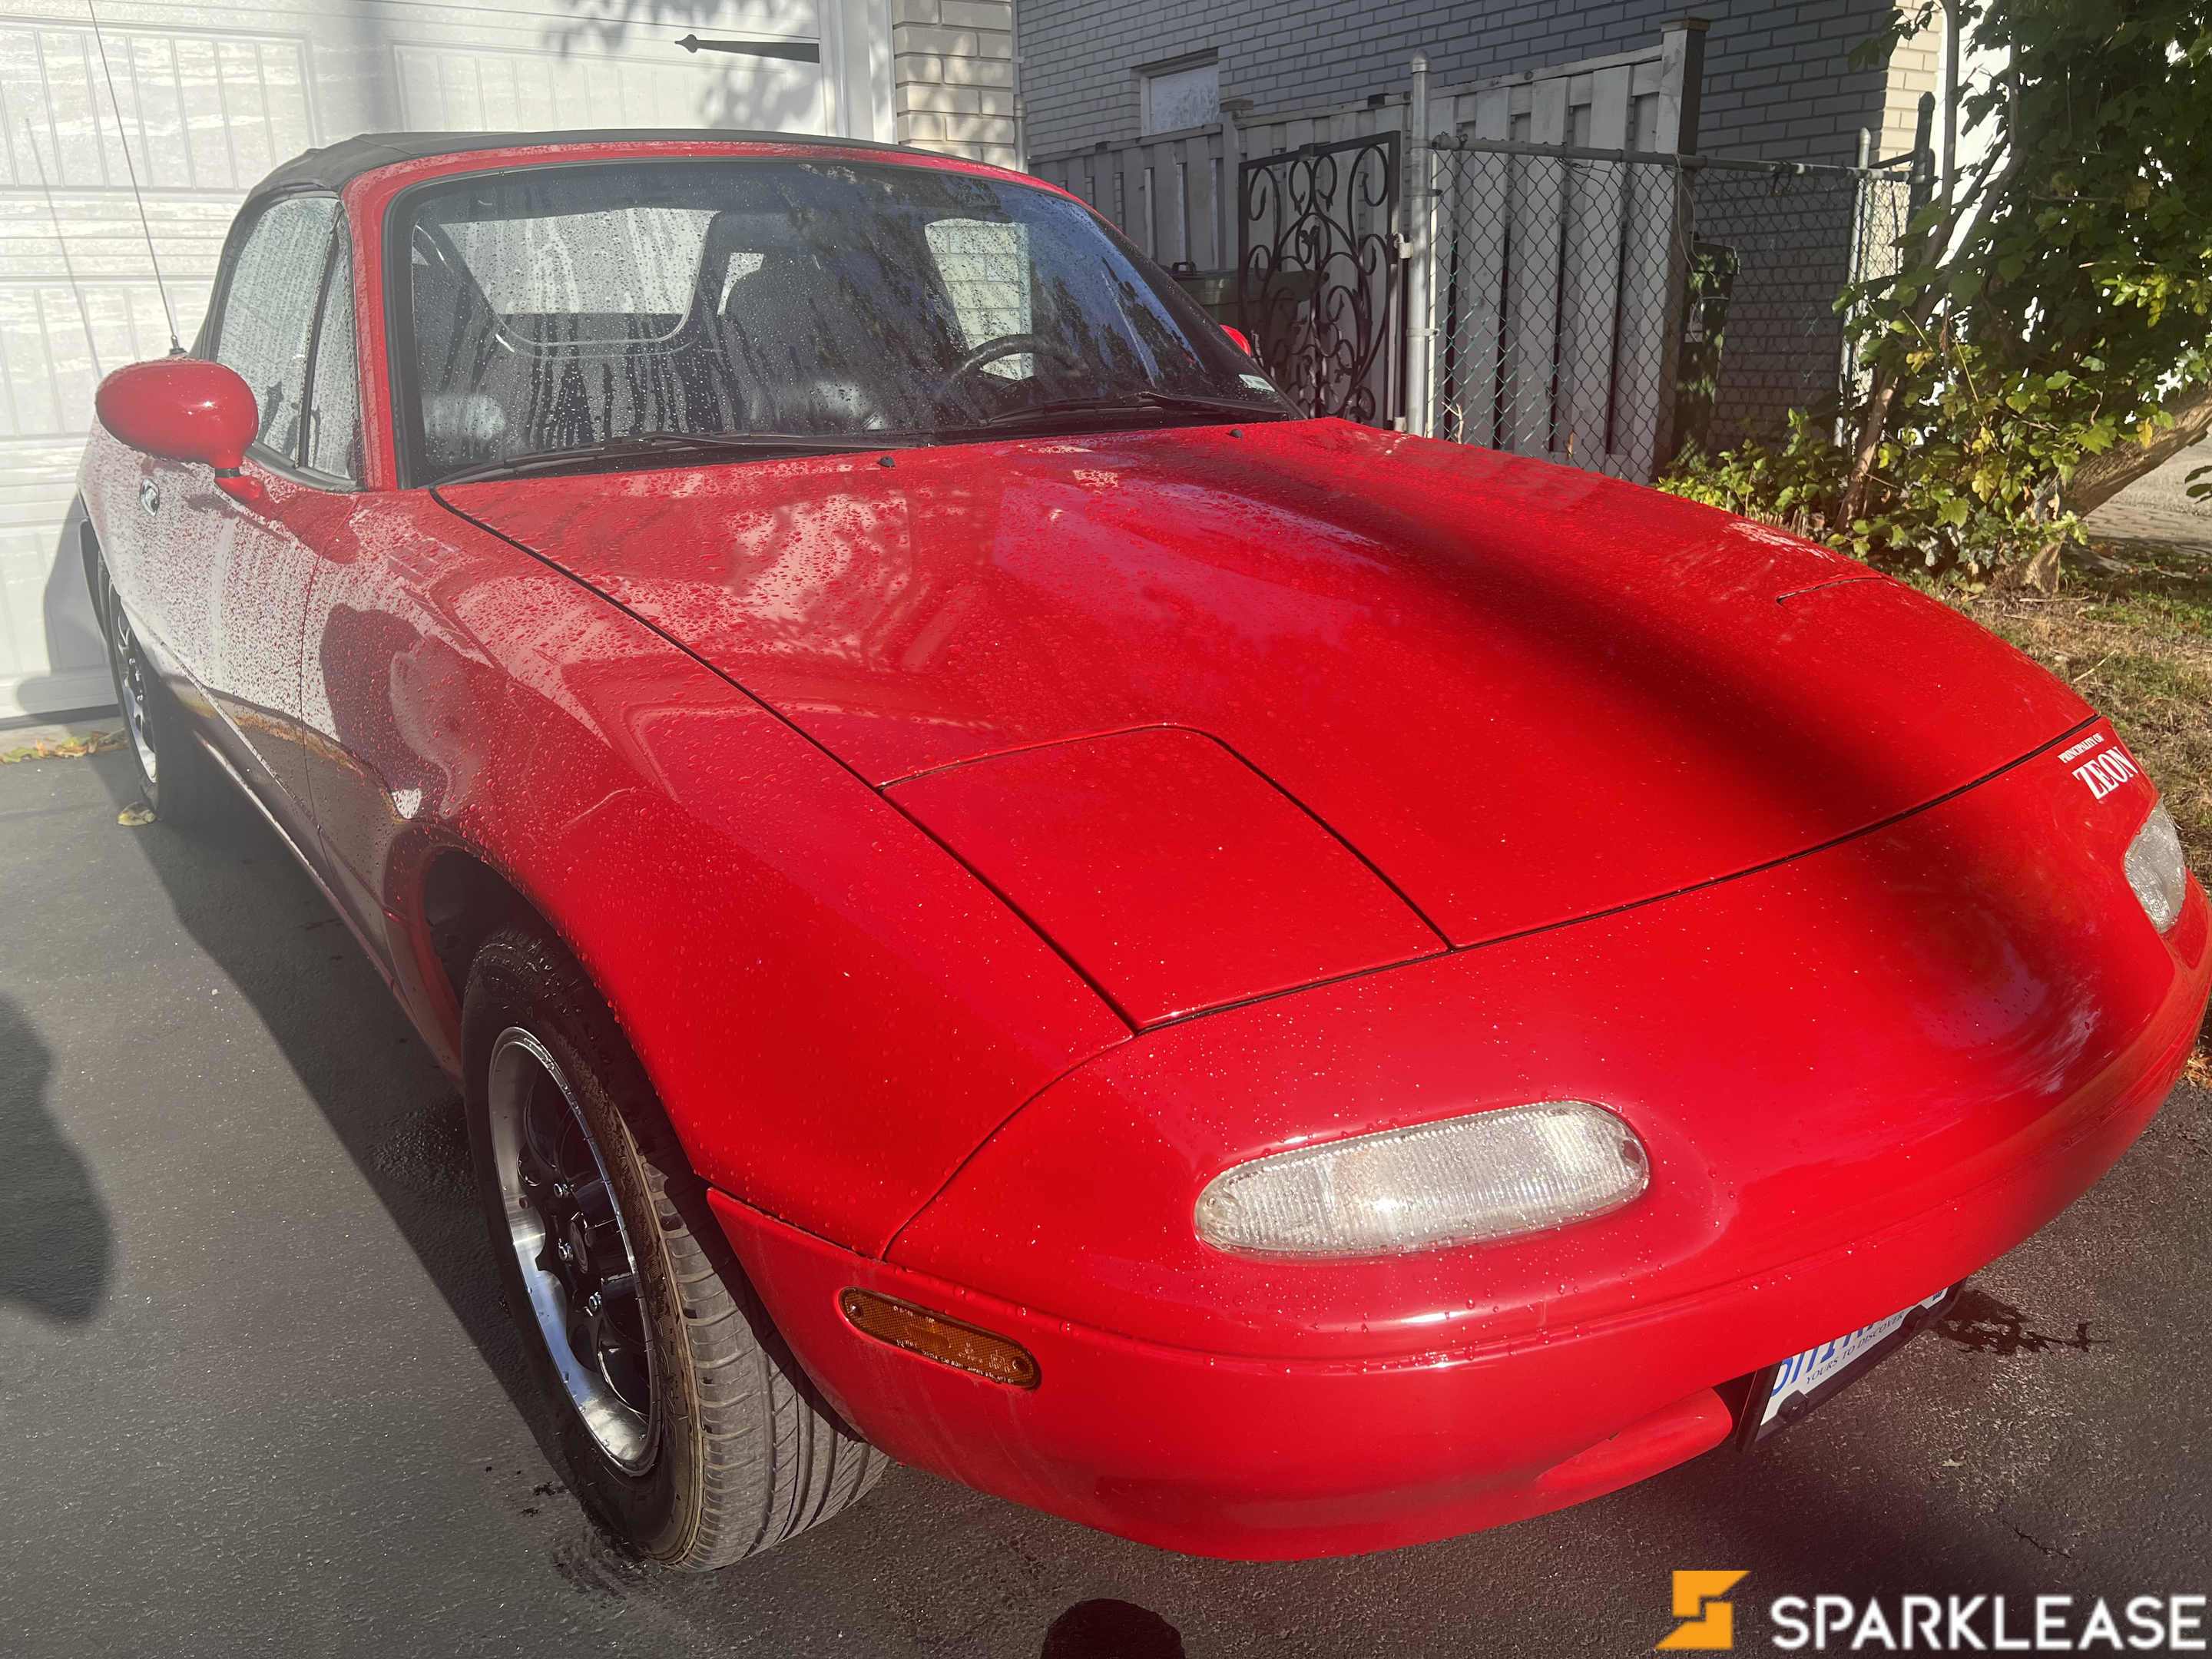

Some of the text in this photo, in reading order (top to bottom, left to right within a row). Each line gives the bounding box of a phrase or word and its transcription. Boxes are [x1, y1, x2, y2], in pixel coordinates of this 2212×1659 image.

[2071, 746, 2139, 800] ZEON
[1806, 1310, 1905, 1384] YOURS TO DISCOVER
